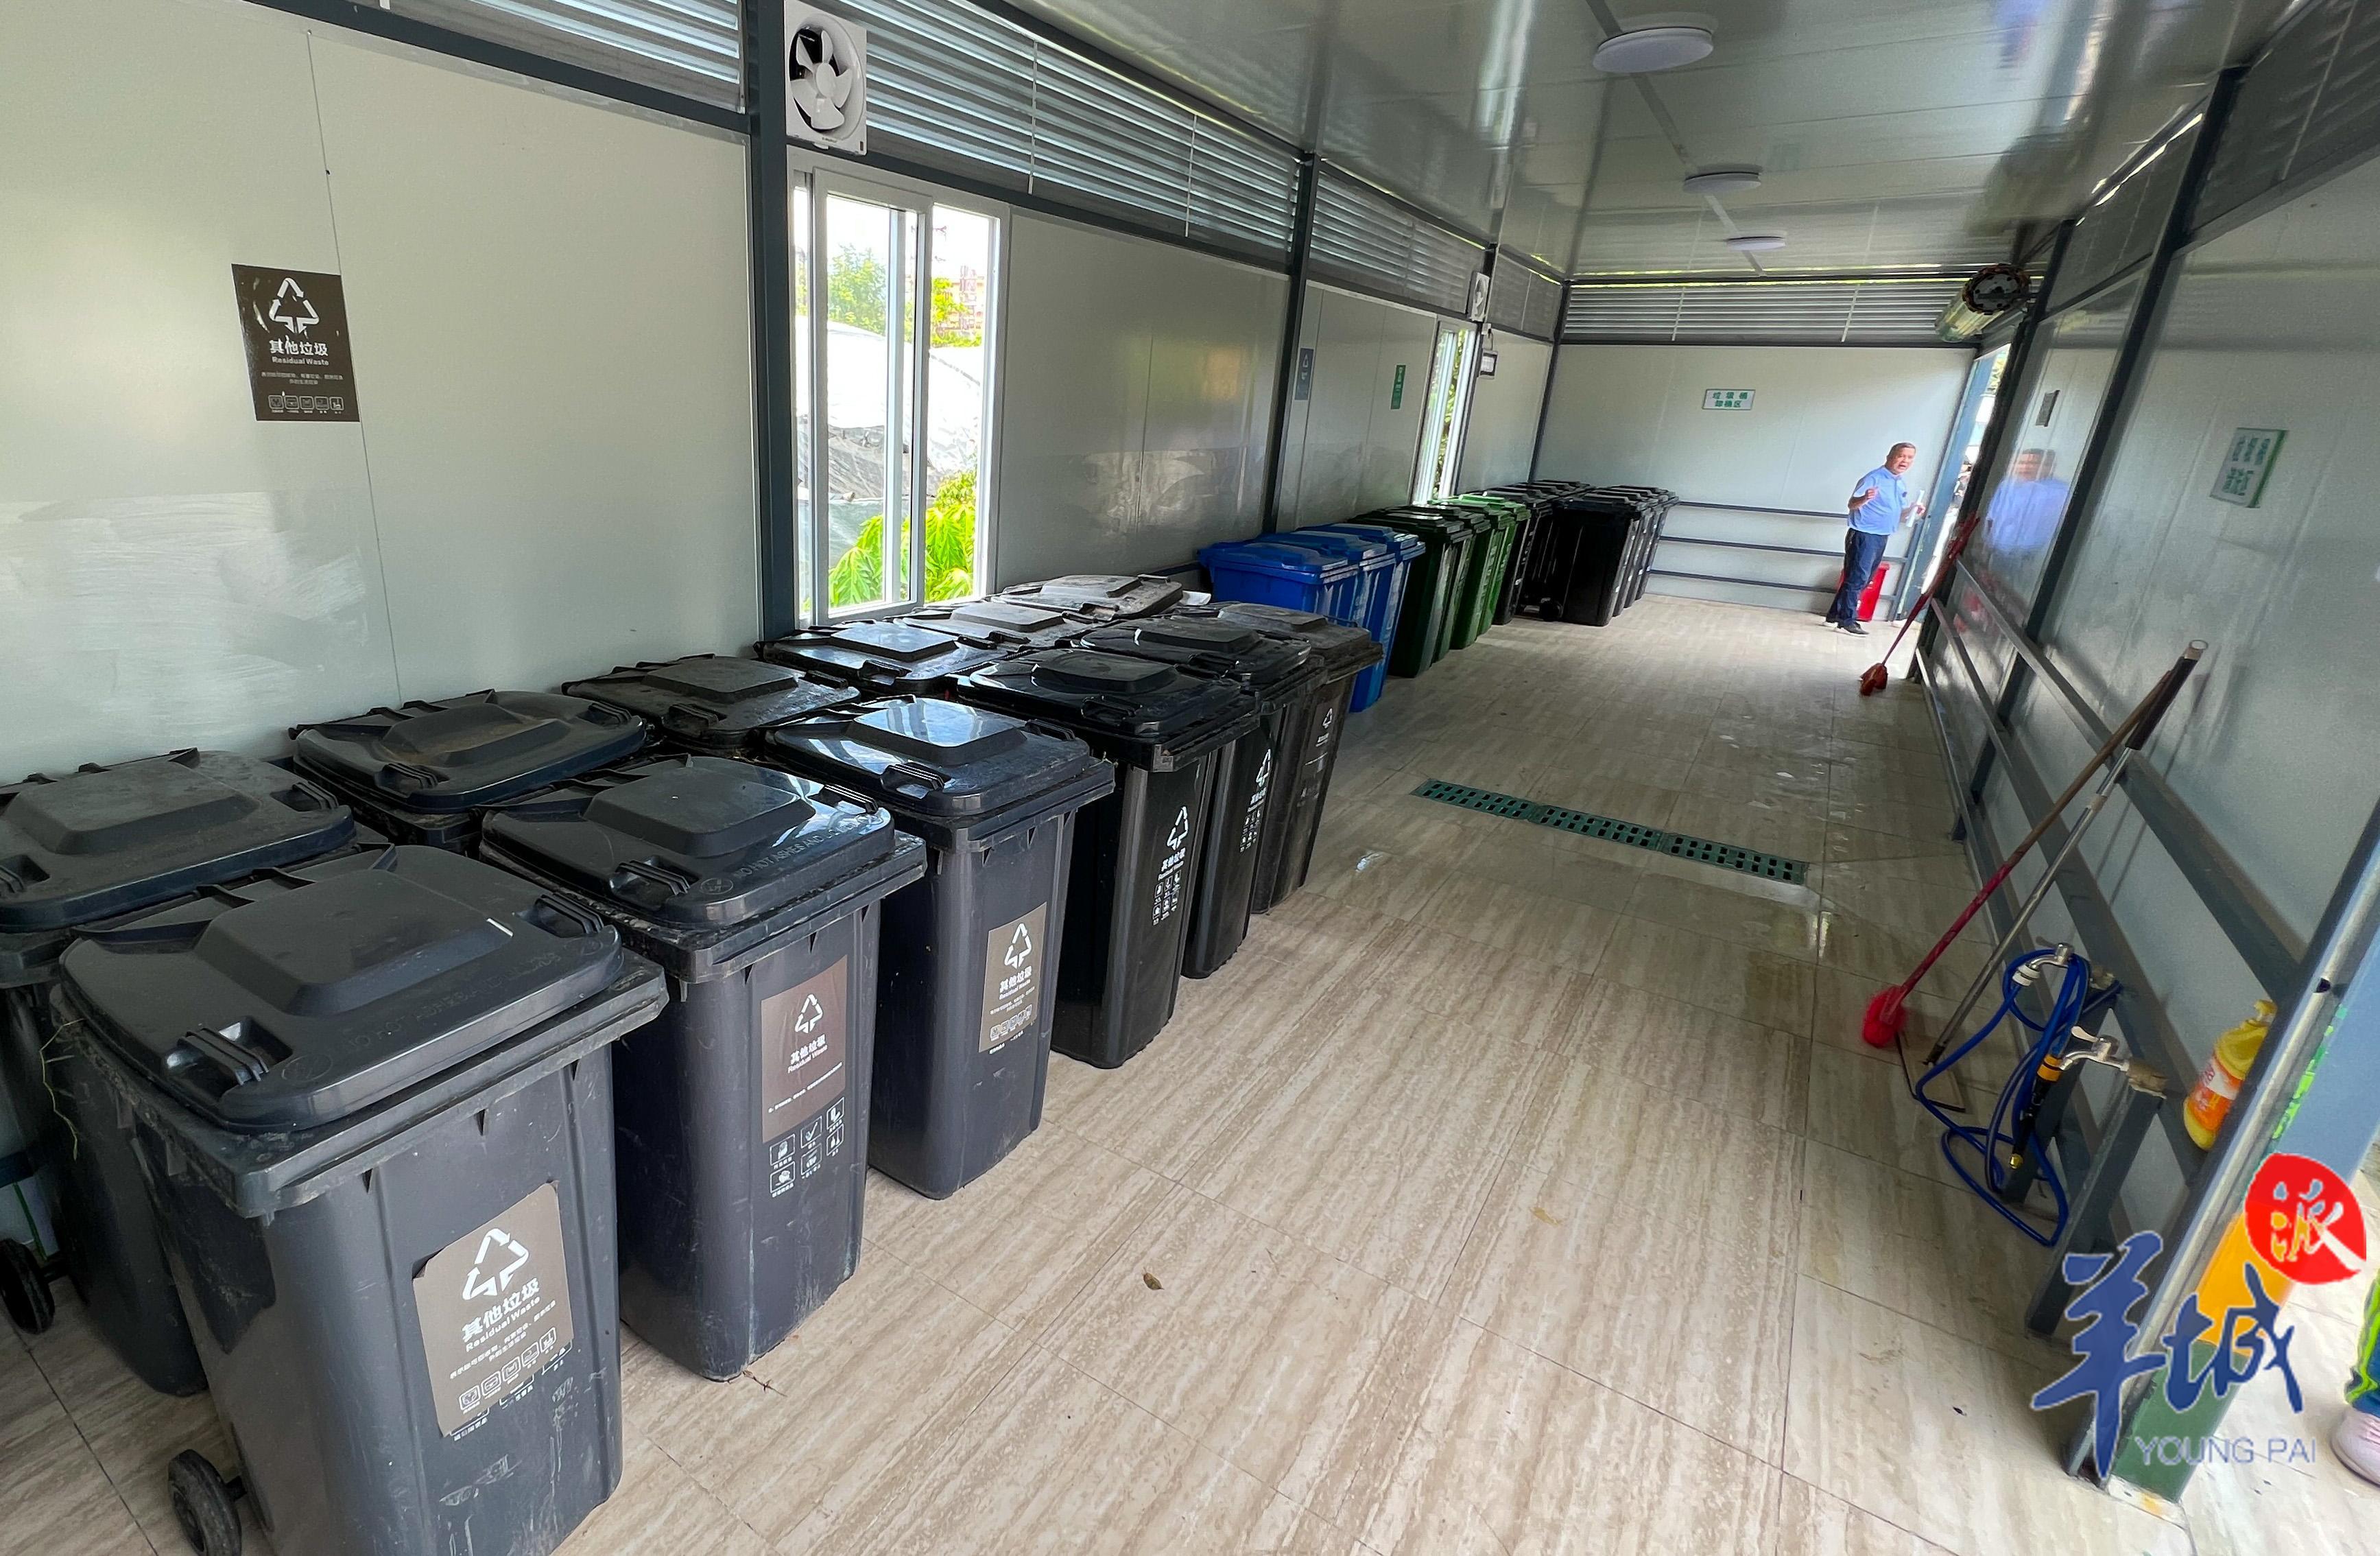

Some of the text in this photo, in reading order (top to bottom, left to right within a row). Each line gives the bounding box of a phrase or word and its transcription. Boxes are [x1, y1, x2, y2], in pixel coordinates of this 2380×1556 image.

[269, 340, 329, 356] 其他垃圾
[272, 357, 305, 365] Residual
[774, 843, 806, 862] ASHES
[803, 835, 824, 849] AND
[999, 965, 1032, 993] 其他垃圾
[790, 1034, 826, 1065] 其他垃圾
[462, 1277, 540, 1343] 其他垃圾
[466, 1296, 540, 1352] Residual Waste
